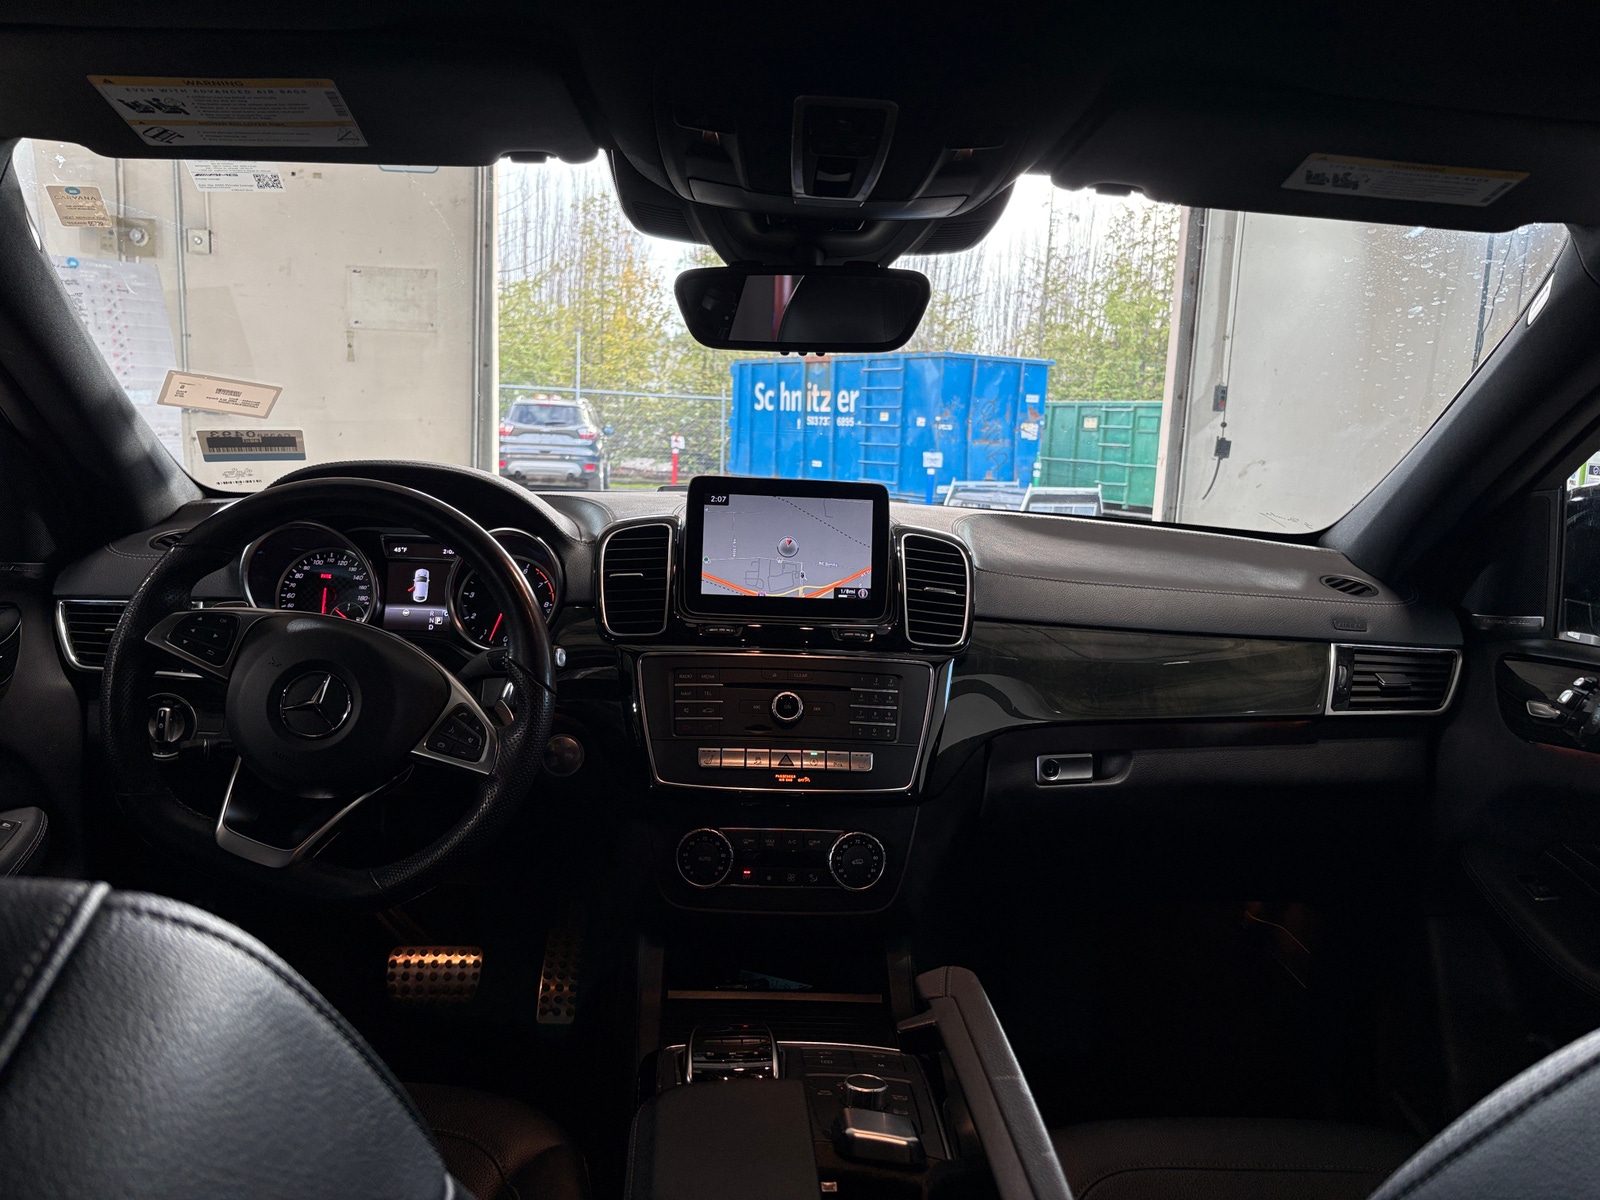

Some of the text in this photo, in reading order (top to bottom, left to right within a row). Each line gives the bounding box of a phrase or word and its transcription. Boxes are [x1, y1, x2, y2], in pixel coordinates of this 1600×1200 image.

[182, 79, 244, 88] WARNING
[523, 567, 529, 575] 6
[537, 581, 544, 589] 7
